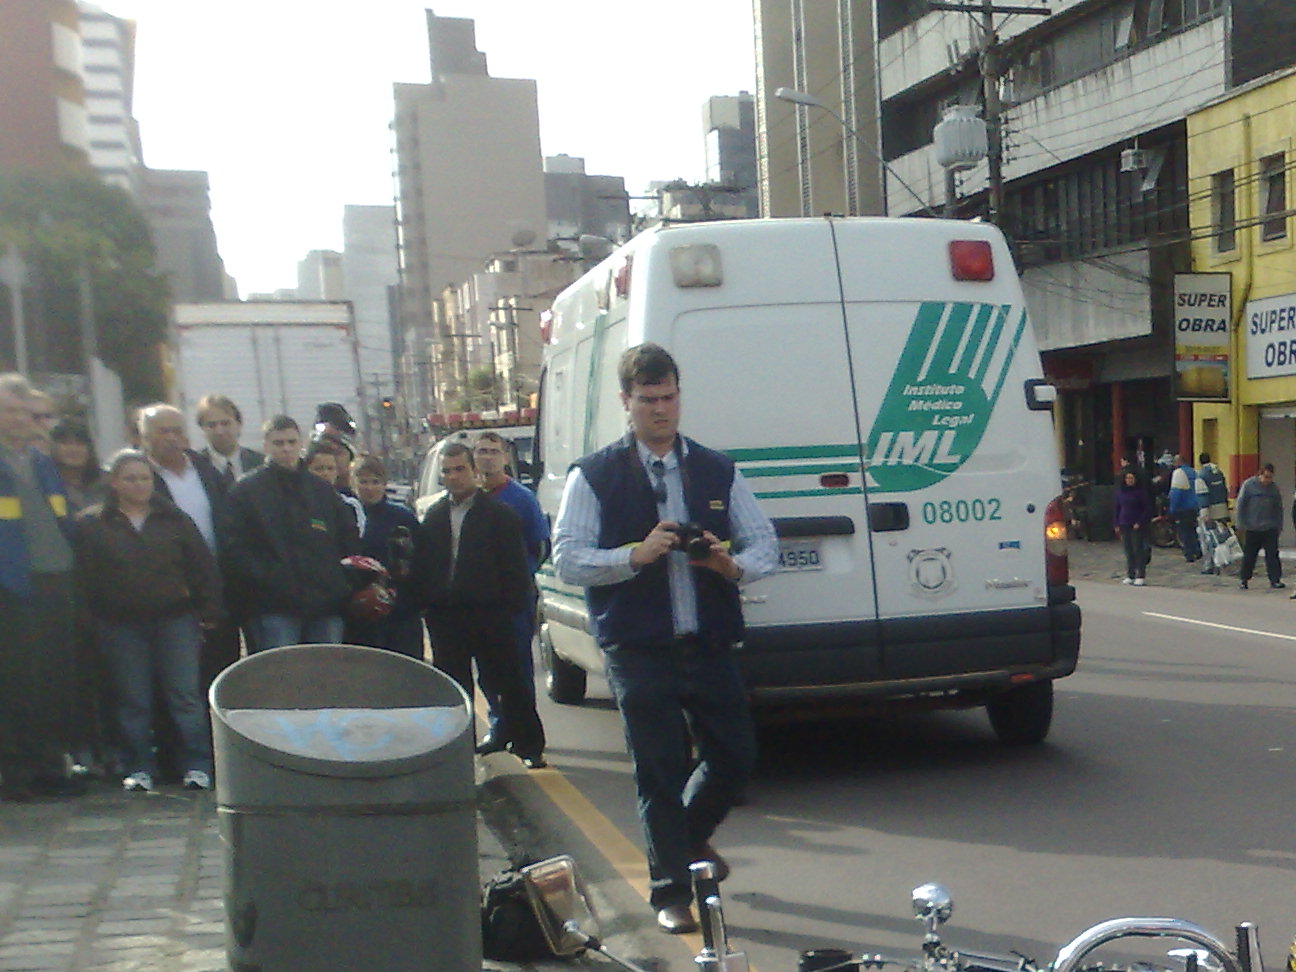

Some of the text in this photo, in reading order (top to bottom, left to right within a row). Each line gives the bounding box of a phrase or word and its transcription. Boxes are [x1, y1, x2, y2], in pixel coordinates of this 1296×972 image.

[1177, 293, 1227, 308] SUPER
[1178, 318, 1227, 332] OBRA
[1251, 306, 1296, 336] SUPER
[903, 383, 965, 396] Instituto
[932, 413, 975, 427] Legal
[870, 430, 961, 465] IML
[923, 498, 1002, 524] 08002
